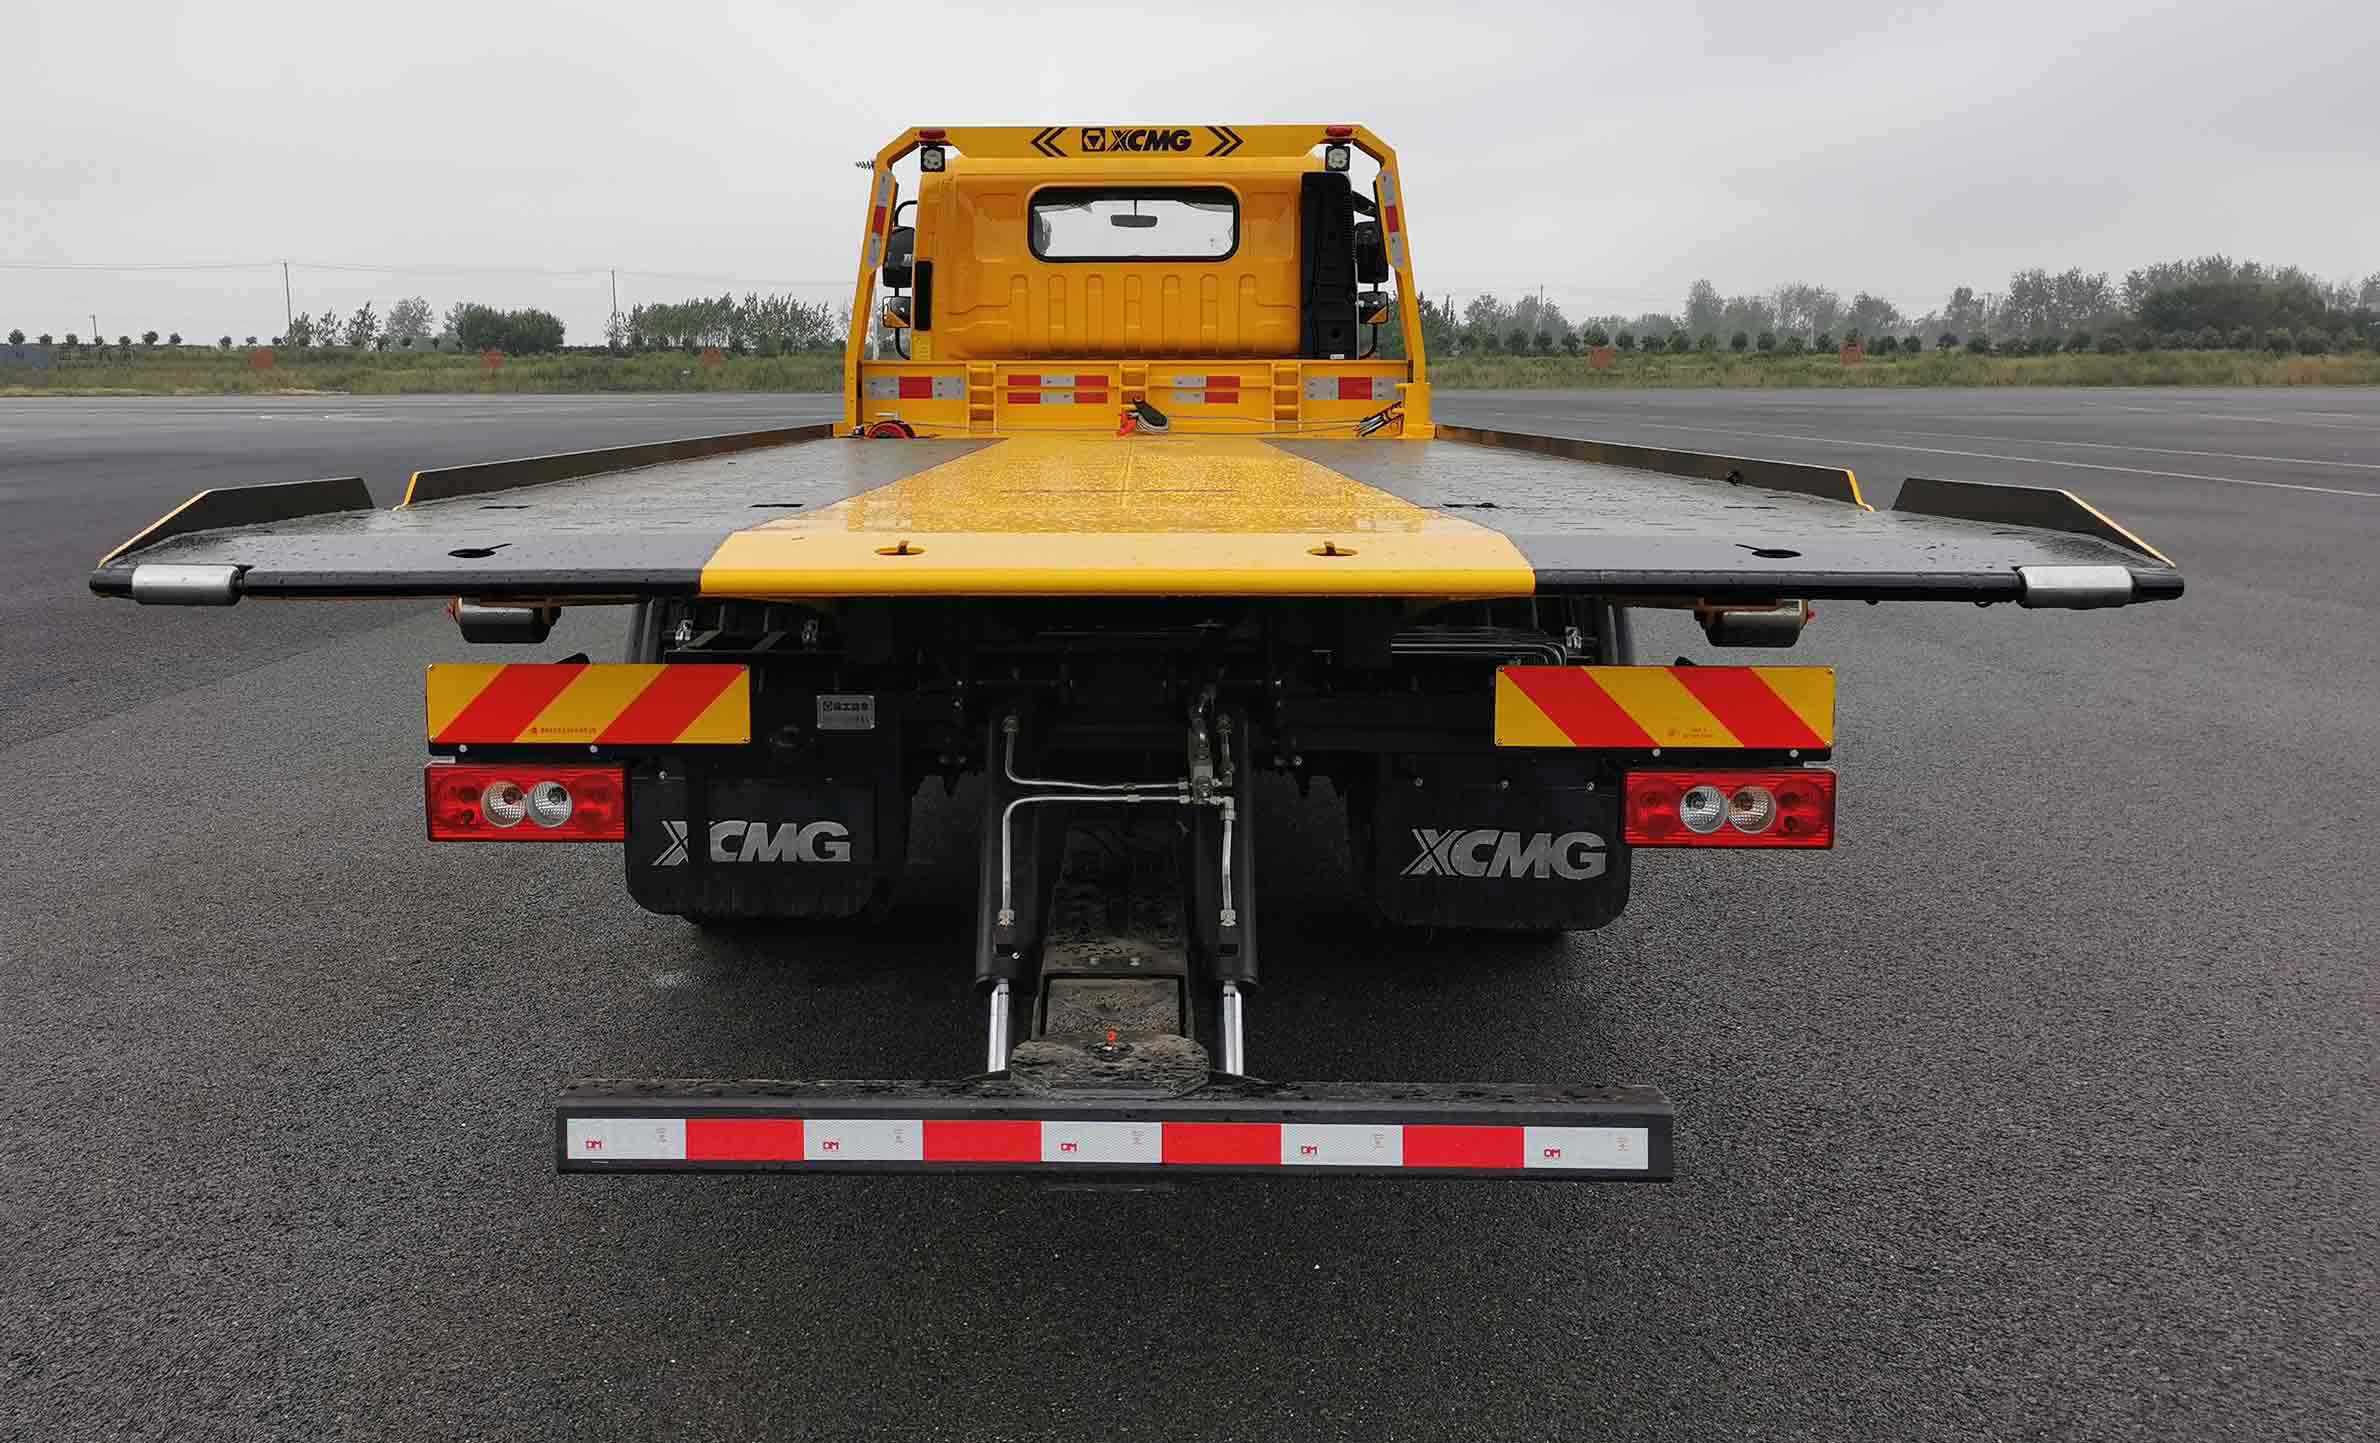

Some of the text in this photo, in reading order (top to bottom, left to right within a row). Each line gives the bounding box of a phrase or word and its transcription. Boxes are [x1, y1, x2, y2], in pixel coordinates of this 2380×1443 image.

[1106, 129, 1193, 152] XCMG
[651, 820, 851, 866] XCMG
[1400, 829, 1607, 880] XCMG
